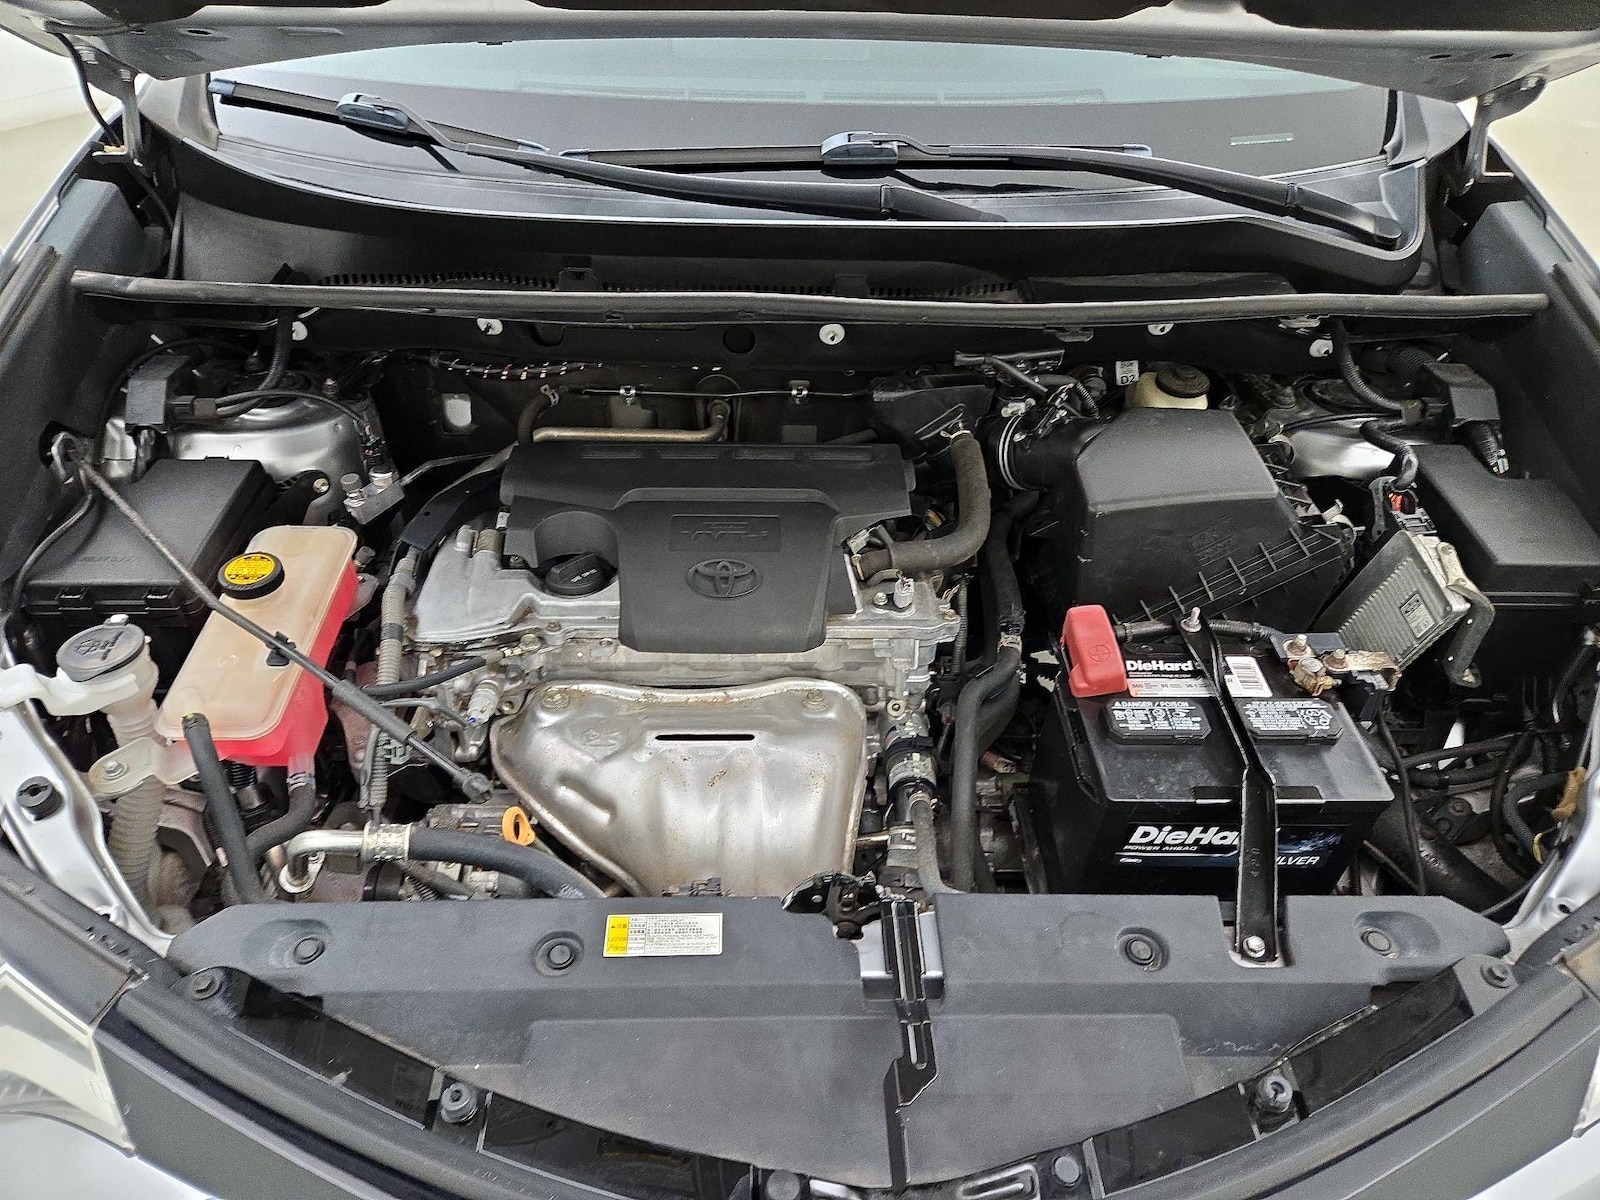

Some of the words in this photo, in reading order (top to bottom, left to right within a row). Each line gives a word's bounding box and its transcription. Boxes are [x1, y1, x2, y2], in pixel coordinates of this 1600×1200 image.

[1120, 374, 1136, 384] D2
[1125, 660, 1194, 671] DieHard
[1128, 825, 1281, 845] DieHa
[1276, 855, 1321, 865] ILVER
